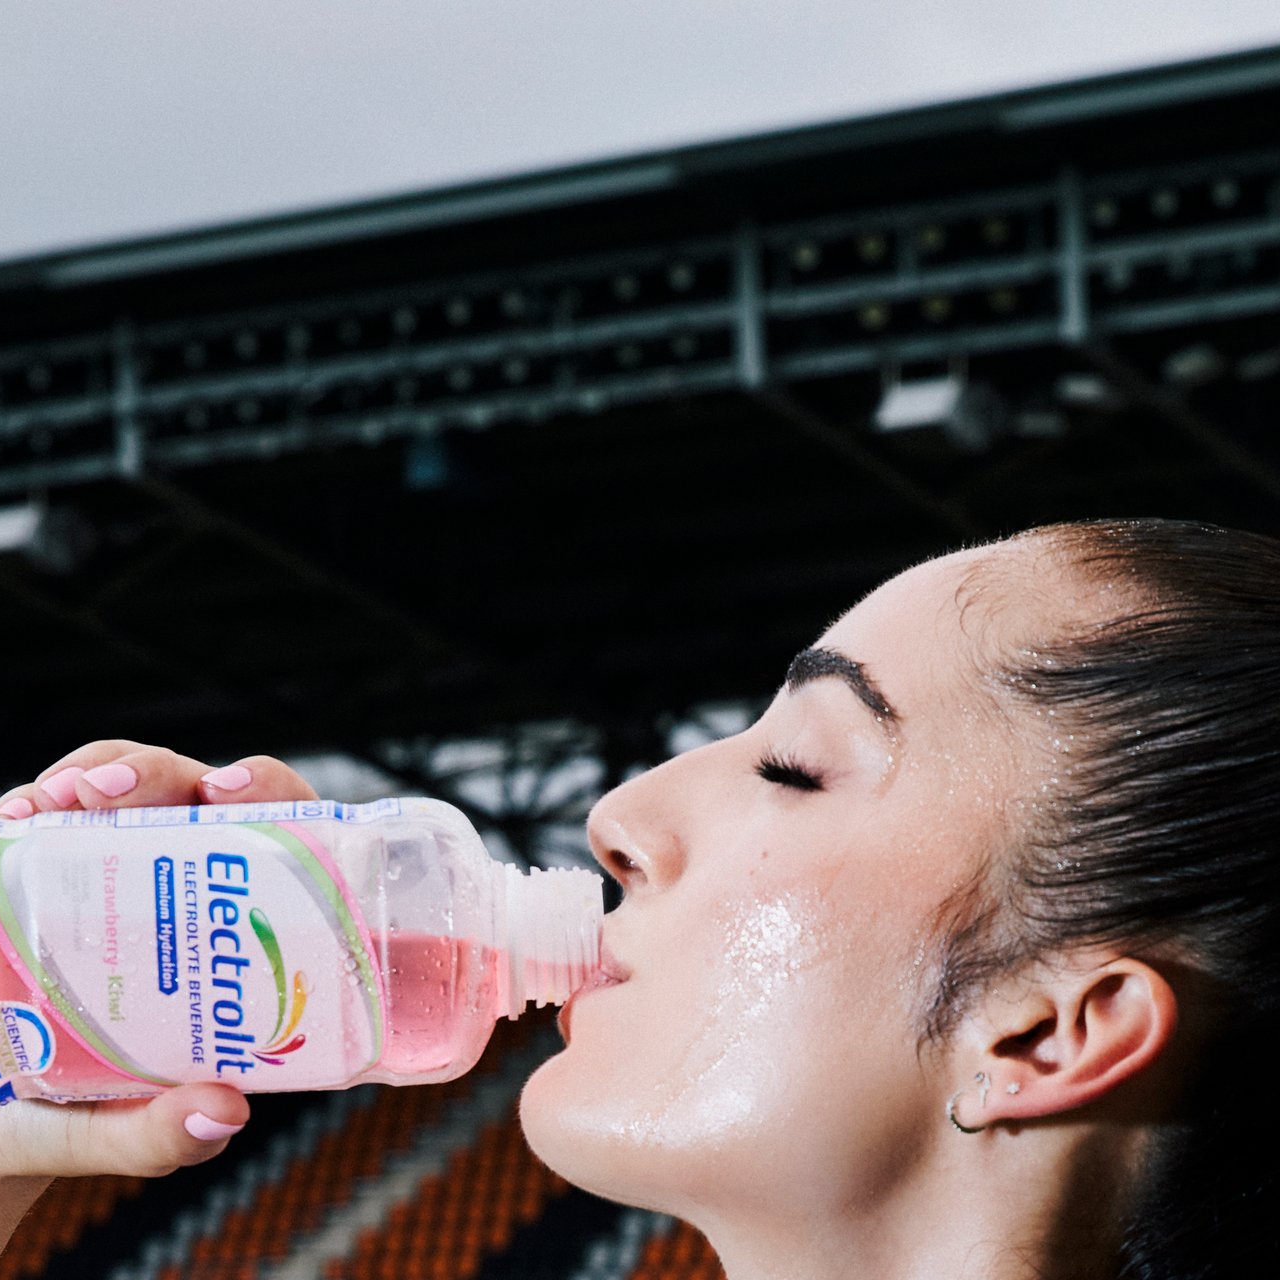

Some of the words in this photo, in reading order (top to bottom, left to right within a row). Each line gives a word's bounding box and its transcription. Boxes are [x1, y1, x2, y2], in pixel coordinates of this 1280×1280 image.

[158, 862, 171, 919] Premium
[184, 861, 200, 974] ELECTROLYTE
[103, 855, 126, 1022] Strawberry-Kiwi
[159, 923, 175, 988] Hydration
[207, 852, 255, 1074] Electrolit
[1, 1007, 32, 1071] SCIENTIFIC
[189, 980, 204, 1064] BEVERAGE
